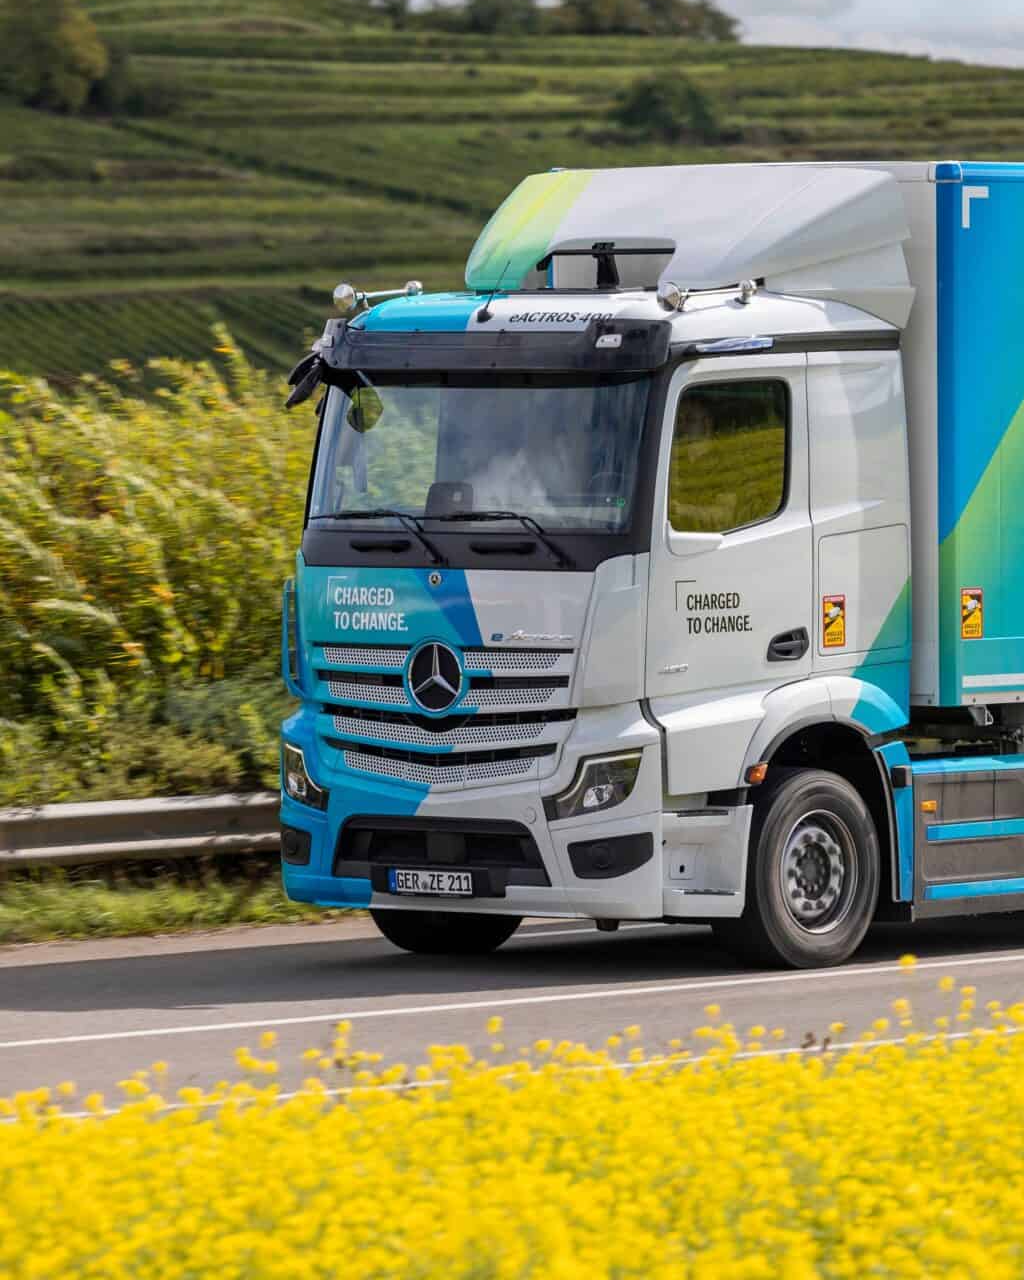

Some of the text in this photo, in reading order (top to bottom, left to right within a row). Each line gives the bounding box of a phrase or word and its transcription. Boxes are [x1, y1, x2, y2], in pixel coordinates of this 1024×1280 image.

[509, 311, 580, 323] eACTROS
[334, 587, 394, 606] CHARGED
[687, 592, 740, 611] CHARGED
[333, 611, 409, 632] TO CHANGE.
[686, 615, 753, 635] TO CHANGE.
[397, 871, 472, 892] GER ZE 211
